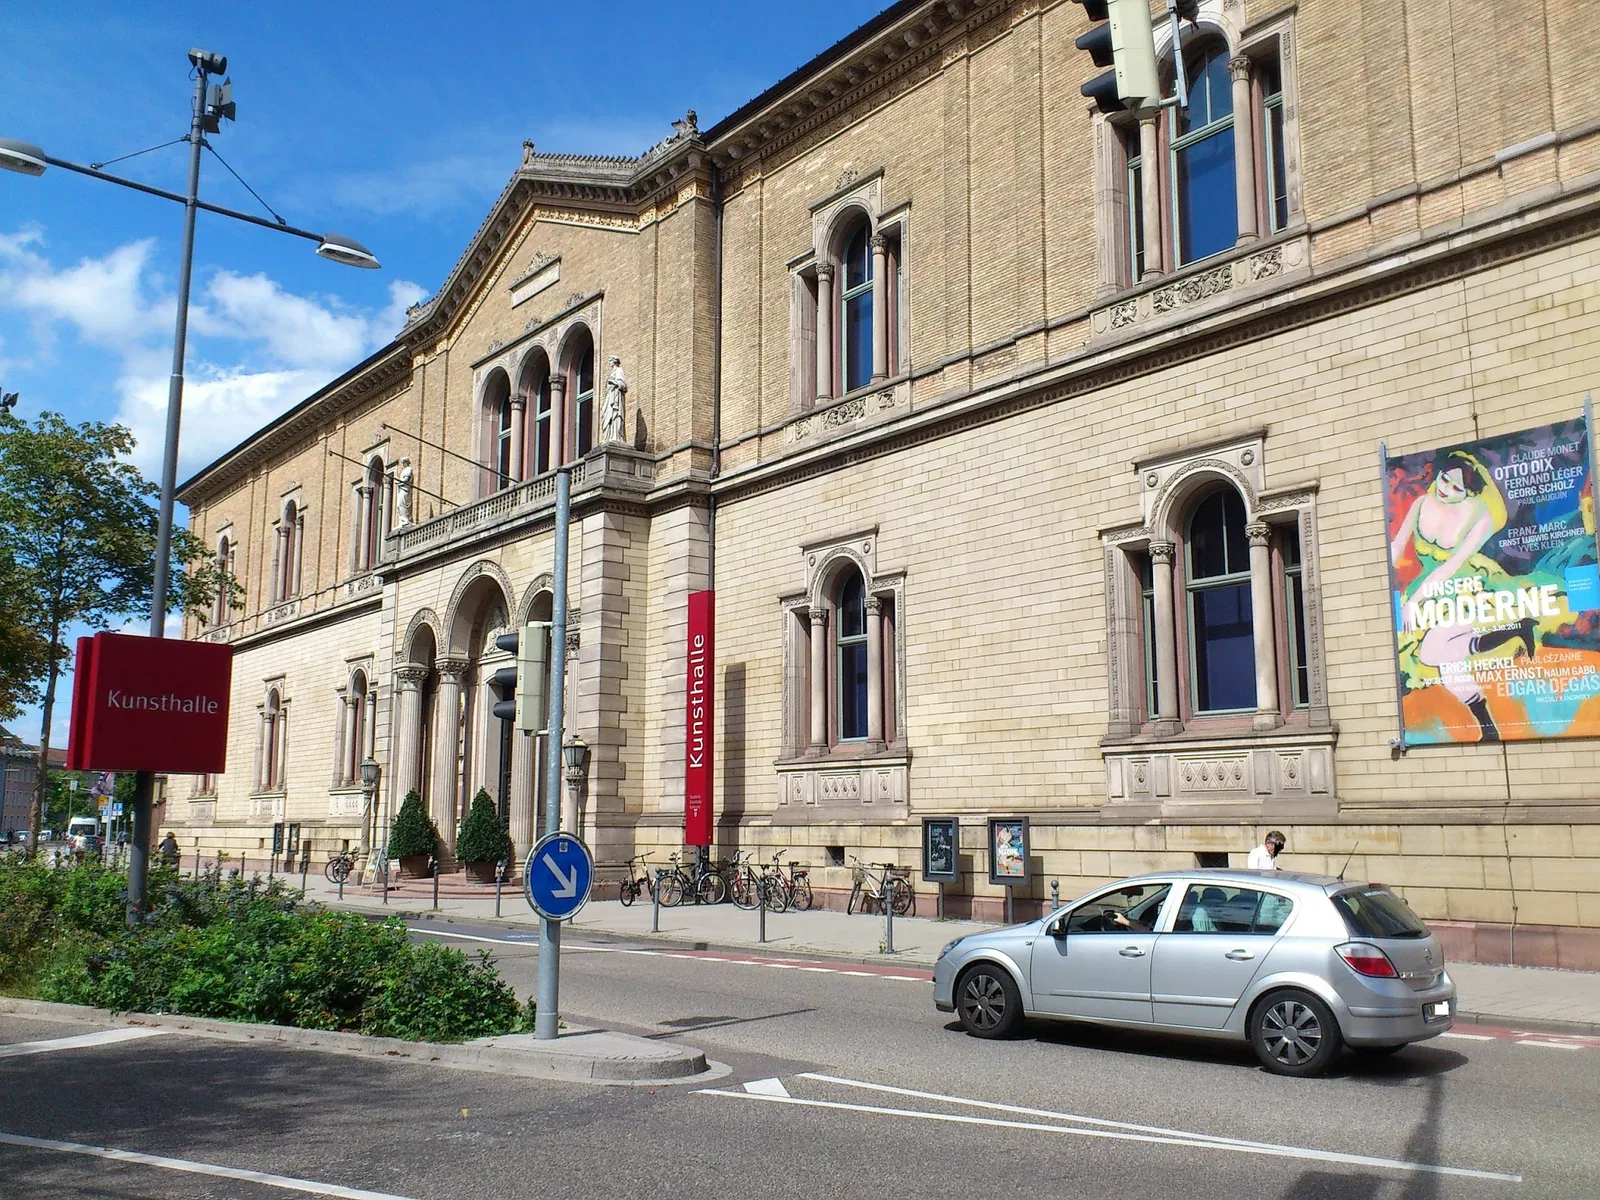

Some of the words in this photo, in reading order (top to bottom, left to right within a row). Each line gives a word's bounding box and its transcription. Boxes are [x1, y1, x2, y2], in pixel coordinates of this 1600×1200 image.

[1511, 450, 1546, 464] CLAUDE
[1547, 441, 1580, 456] MONET
[1494, 462, 1528, 480] OTTO
[1531, 457, 1554, 474] DIX
[1504, 472, 1550, 490] FERNAND
[1551, 466, 1583, 481] LÉGER
[1507, 487, 1537, 500] GEORG
[1539, 479, 1575, 494] SCHOLZ
[1517, 496, 1535, 506] PAUL
[1536, 491, 1567, 503] GAUGUIN
[1498, 537, 1521, 548] ERNST
[1521, 533, 1549, 544] LUDWIG
[1550, 527, 1585, 540] KIRCHNER
[1508, 525, 1537, 538] FRANZ
[1539, 520, 1567, 533] MARC
[1518, 542, 1540, 552] YVES
[1541, 539, 1564, 549] KLEIN
[1423, 575, 1483, 598] UNSERE
[1409, 583, 1561, 631] MODERNE
[1439, 661, 1471, 674] ERICH
[1474, 656, 1517, 671] HECKEL
[1521, 655, 1542, 665] PAUL
[1543, 652, 1583, 664] CÉZANNE
[1422, 675, 1453, 686] AUGUSTE
[1475, 670, 1503, 683] MAX
[1504, 666, 1543, 681] ERNST
[1544, 667, 1570, 677] NAUM
[1571, 665, 1596, 675] GABO
[1497, 679, 1547, 697] EDGAR
[1550, 673, 1600, 693] DEGAS
[108, 689, 218, 714] Kunsthalle
[690, 634, 704, 768] Kunsthalle
